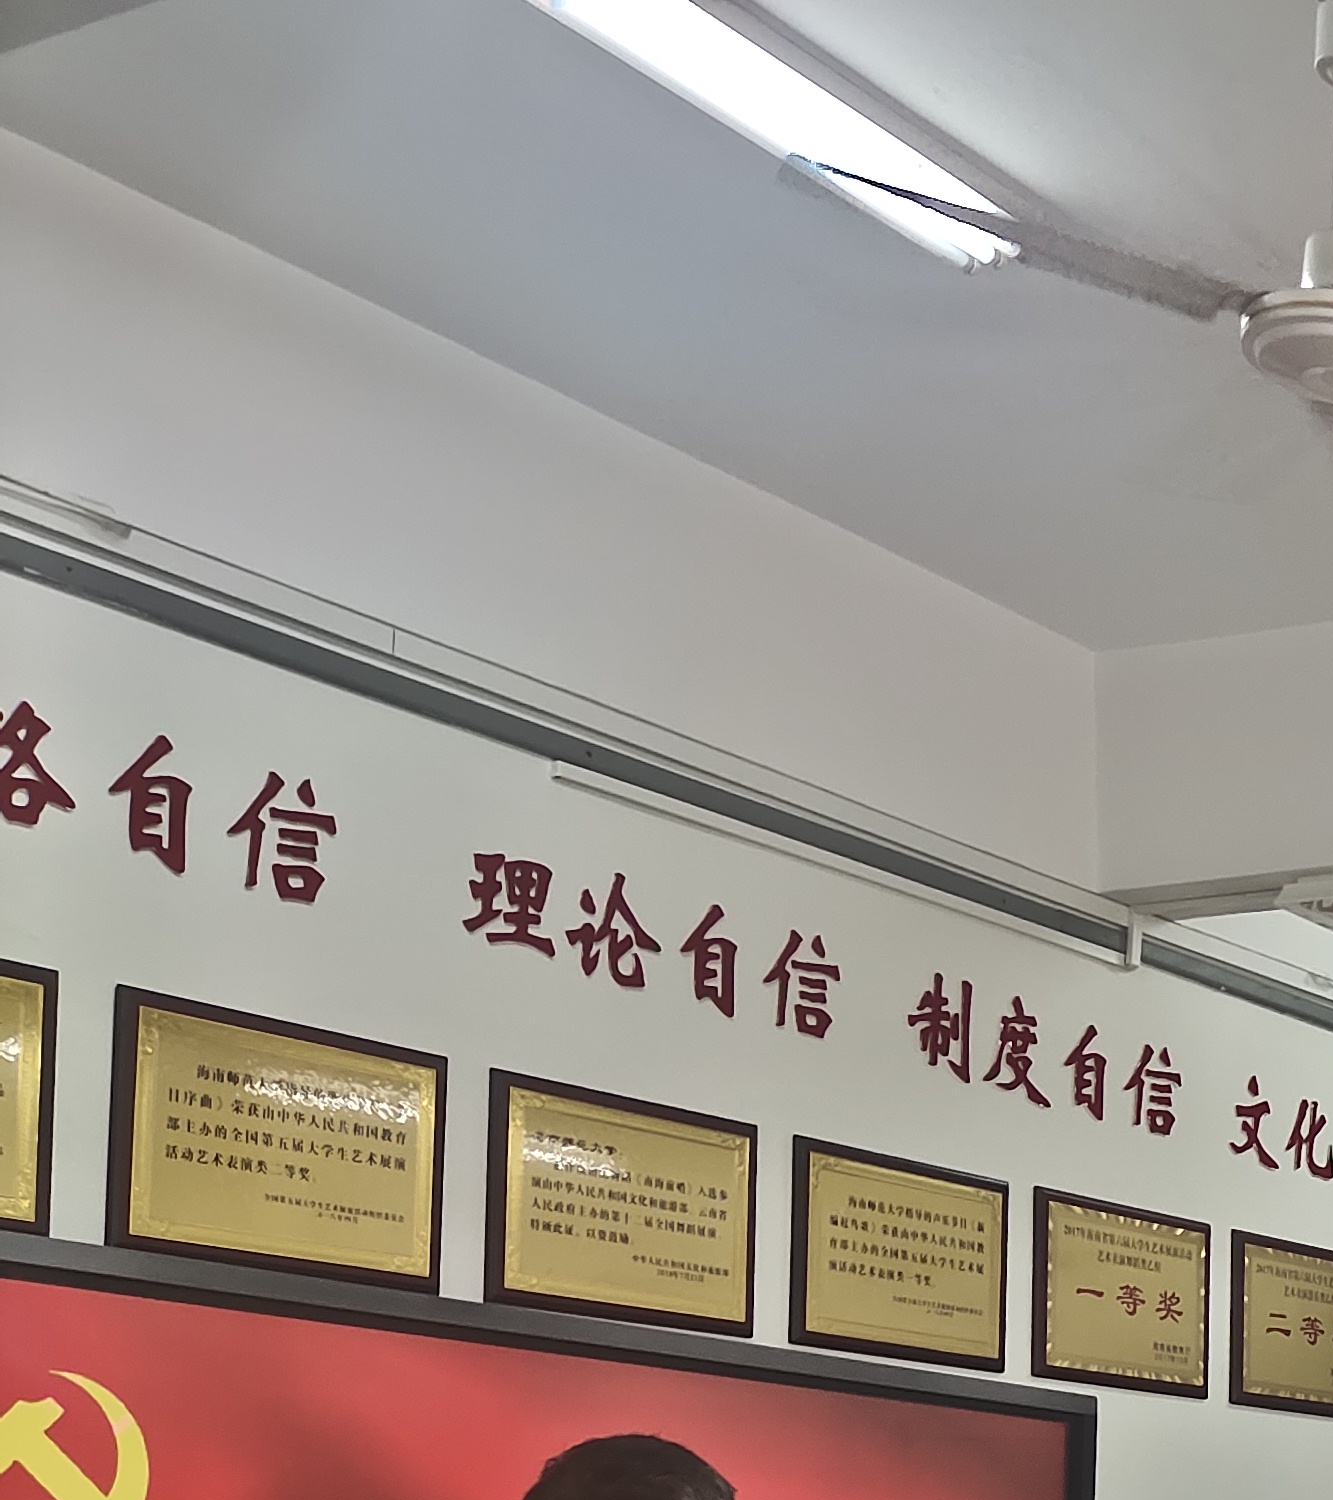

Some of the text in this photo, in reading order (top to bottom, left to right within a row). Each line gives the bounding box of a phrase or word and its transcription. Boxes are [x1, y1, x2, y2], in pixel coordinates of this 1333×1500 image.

[463, 853, 840, 1038] 理论自信
[907, 973, 1182, 1136] 制度自信
[1075, 1273, 1183, 1325] 一等奖
